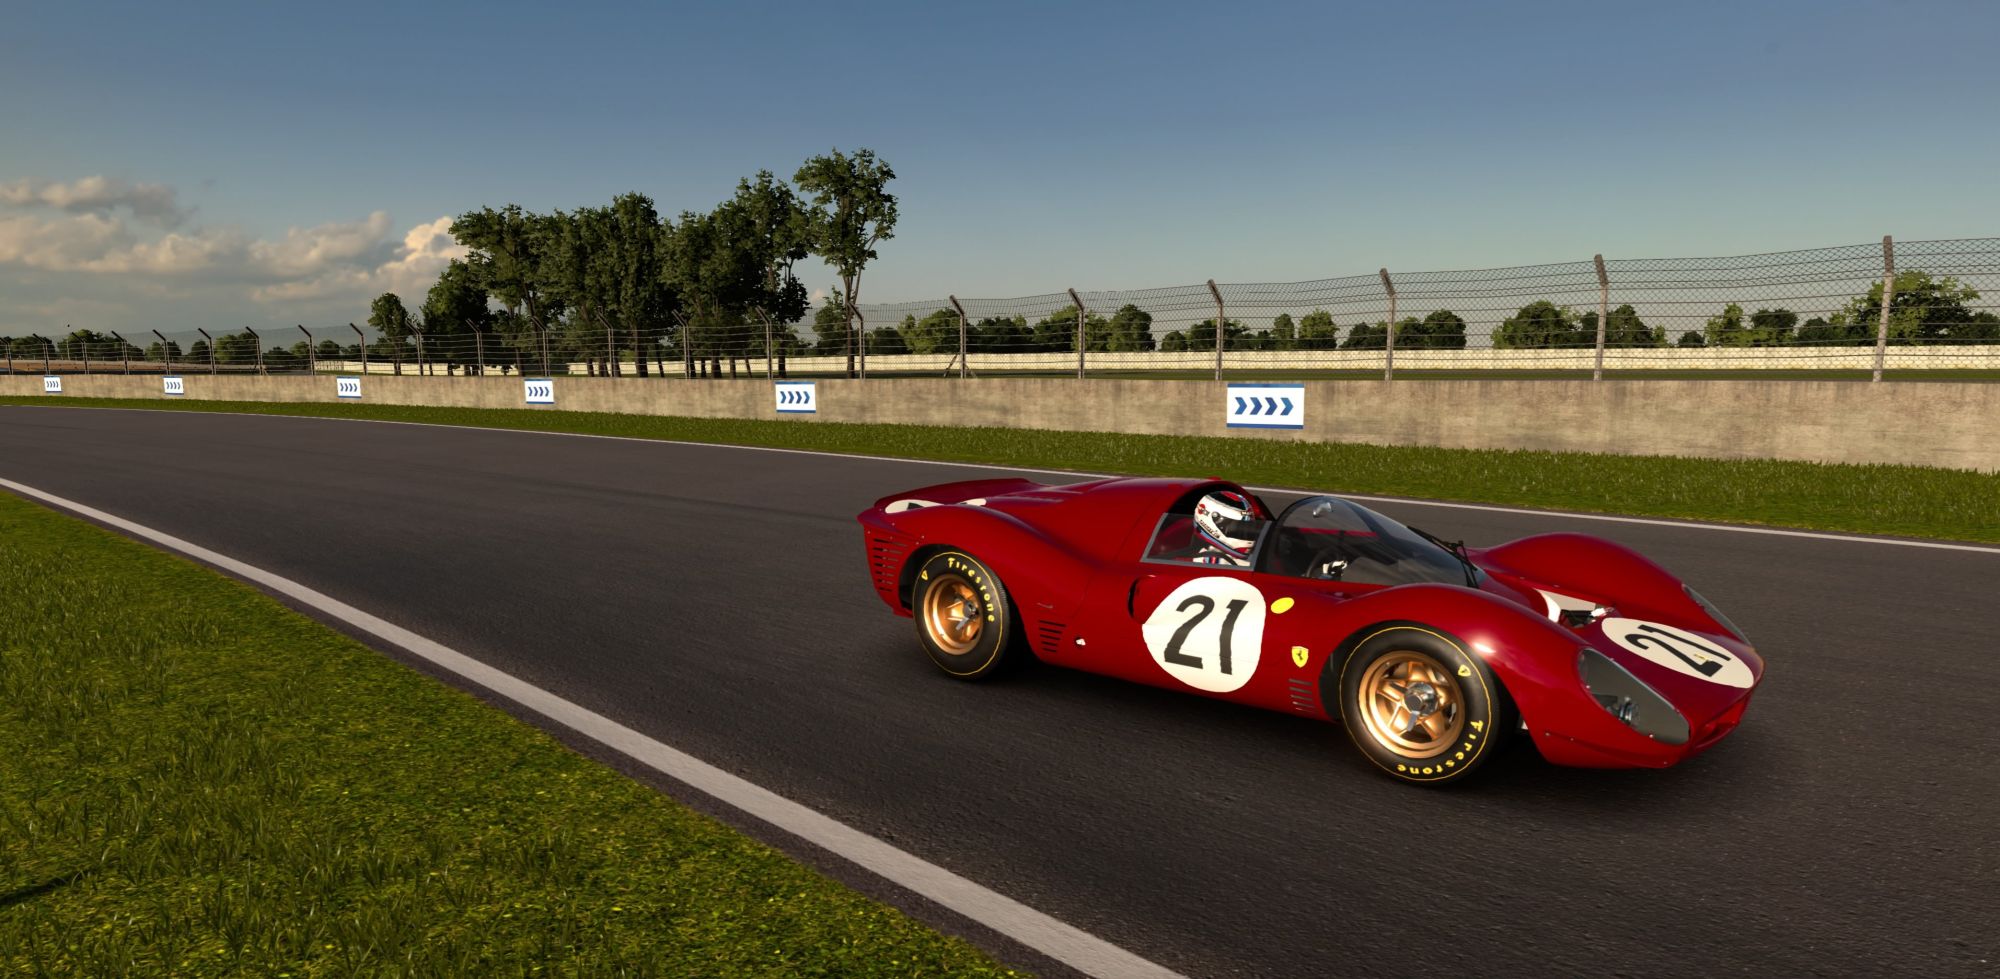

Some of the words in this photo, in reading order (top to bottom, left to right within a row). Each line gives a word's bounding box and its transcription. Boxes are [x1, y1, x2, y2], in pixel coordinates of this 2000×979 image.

[948, 557, 995, 622] Firestone
[1164, 595, 1249, 675] 21
[1624, 624, 1732, 677] 21
[1397, 720, 1484, 775] Firestone
